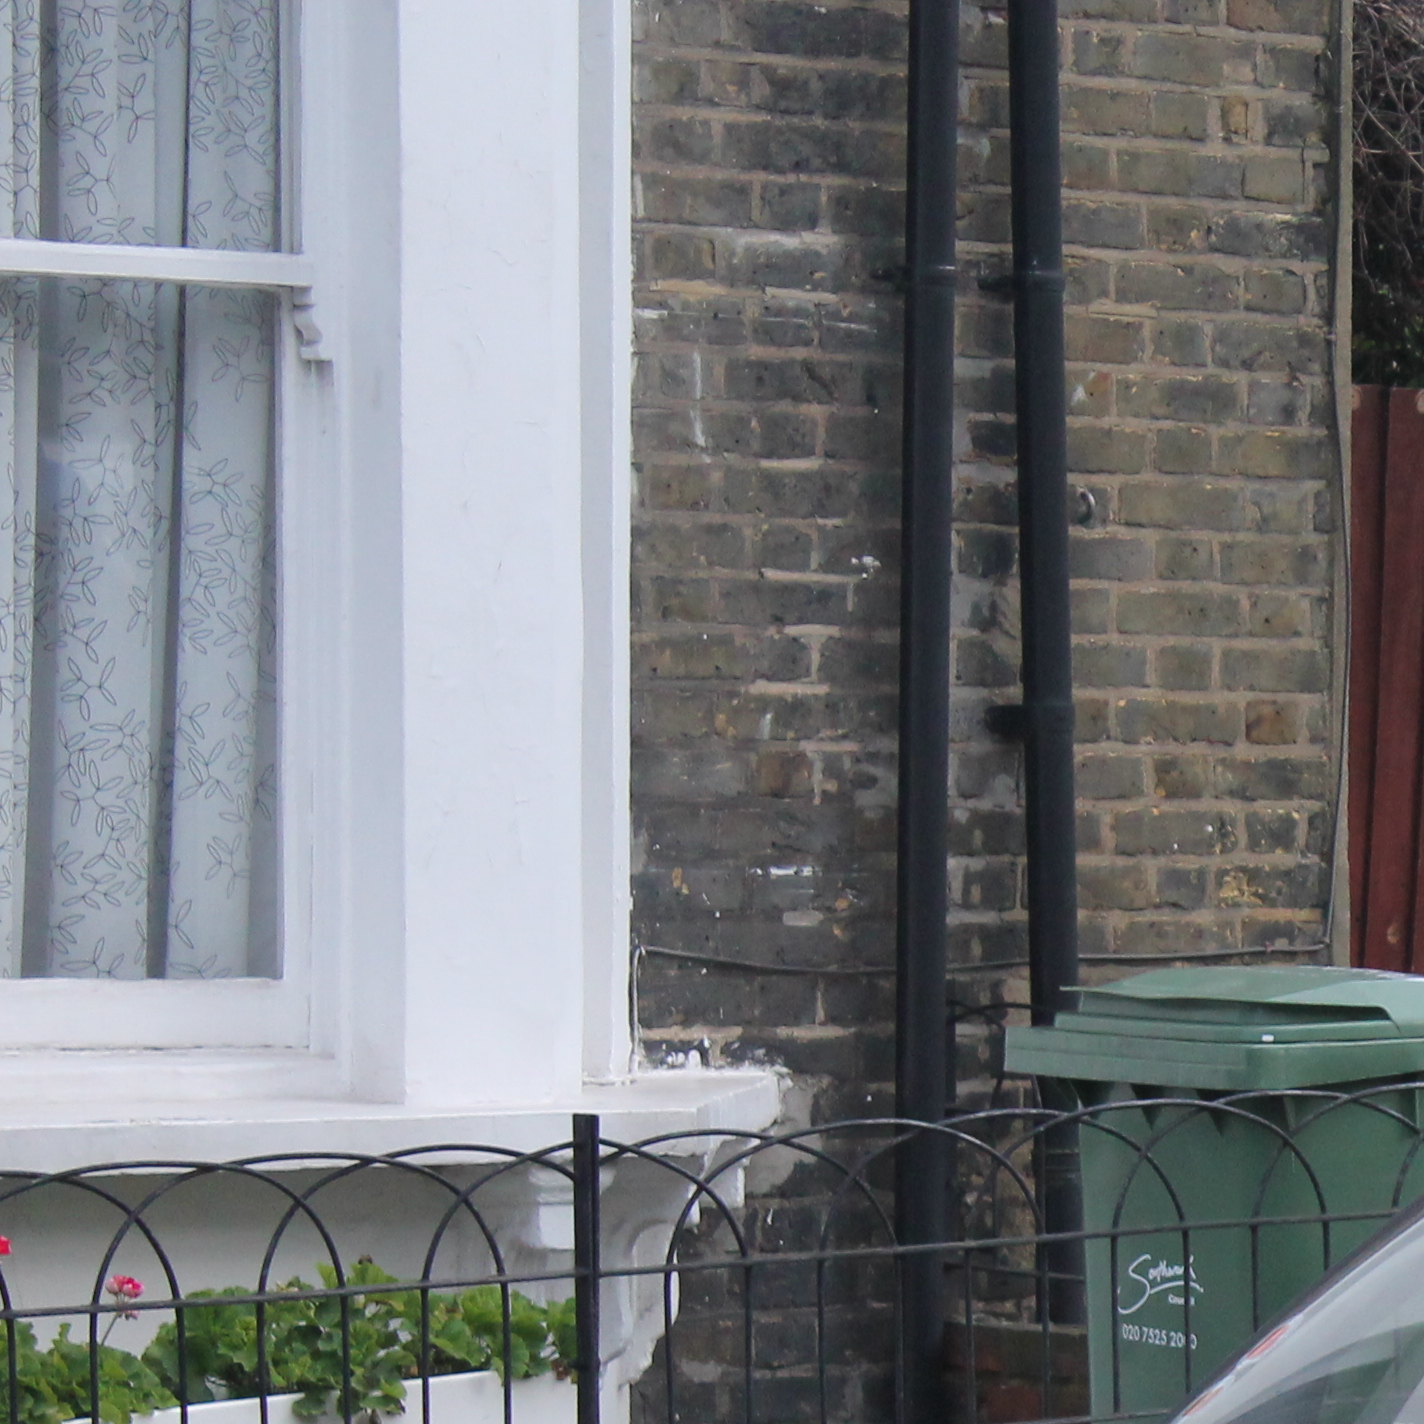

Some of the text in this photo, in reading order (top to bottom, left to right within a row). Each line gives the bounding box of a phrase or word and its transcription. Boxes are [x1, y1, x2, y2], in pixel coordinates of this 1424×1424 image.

[1122, 1323, 1197, 1349] 020 7525 200
